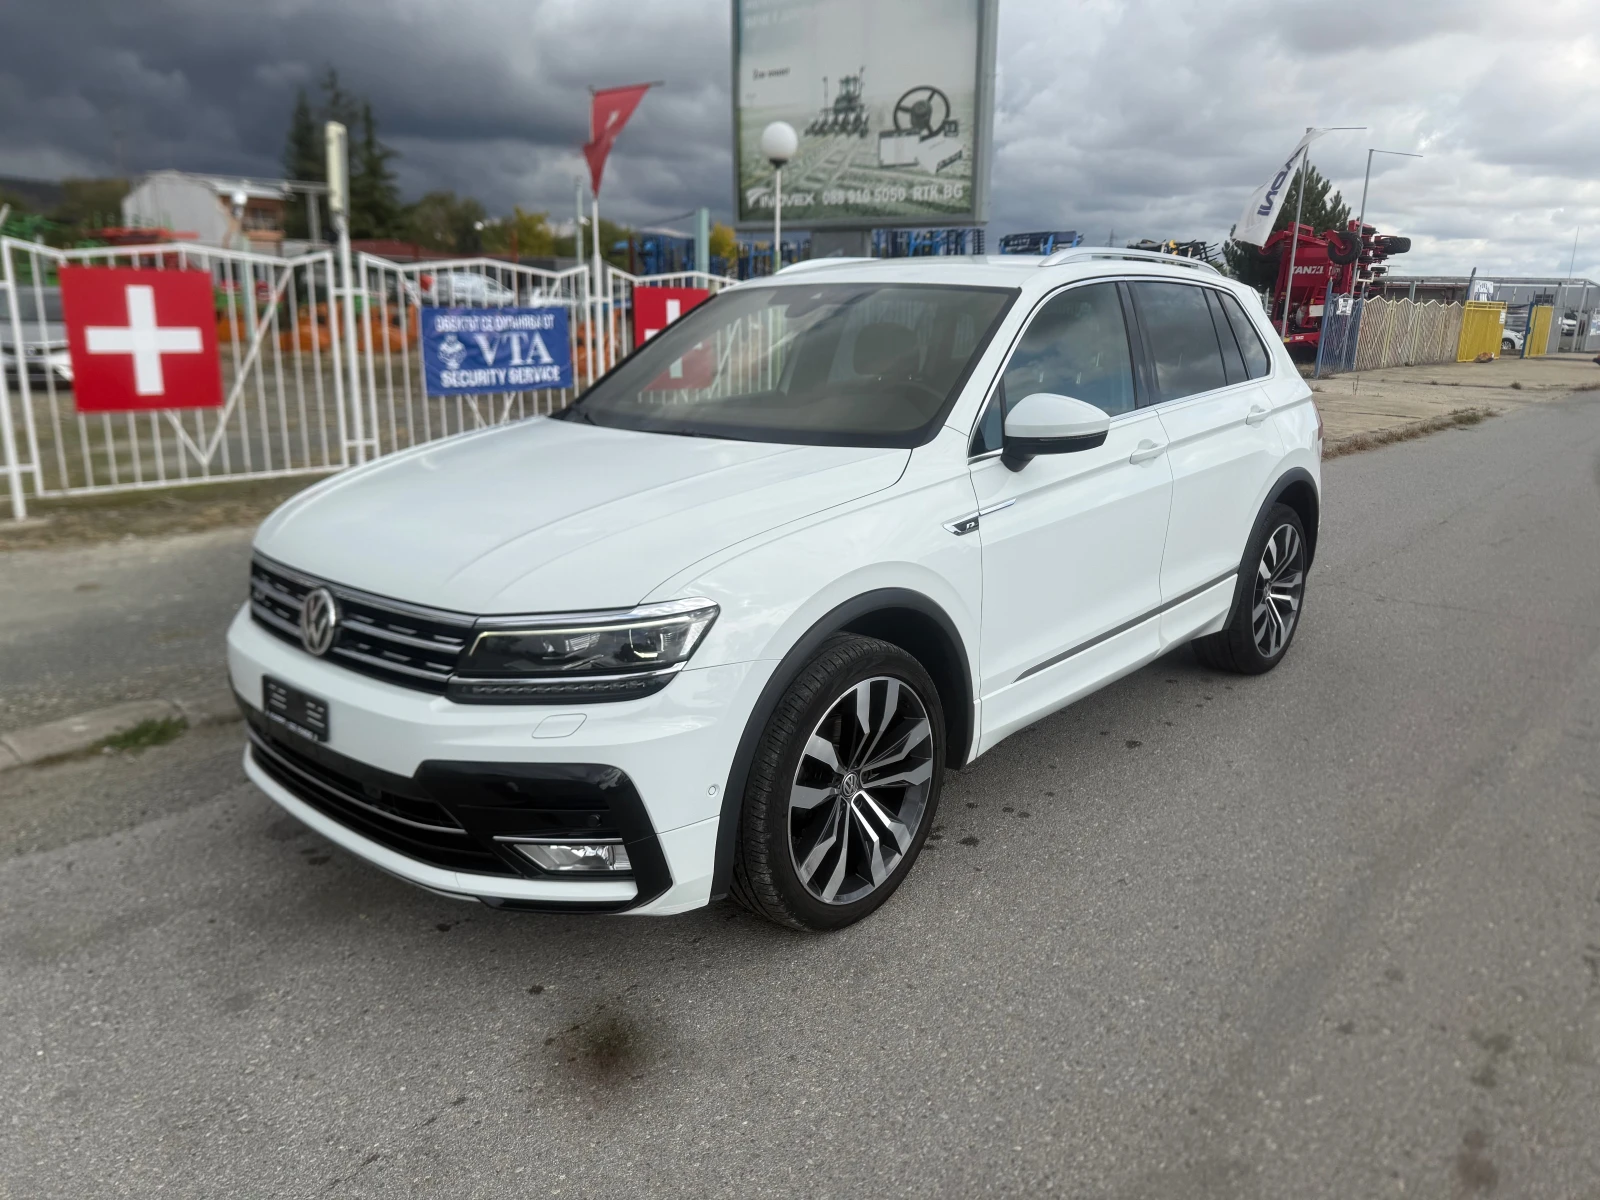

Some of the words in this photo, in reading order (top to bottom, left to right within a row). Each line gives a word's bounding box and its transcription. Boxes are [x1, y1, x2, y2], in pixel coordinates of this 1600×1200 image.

[912, 184, 964, 202] RTK.BG
[473, 331, 554, 367] VTA
[440, 368, 507, 388] SECURITY
[508, 365, 560, 385] SERVICE
